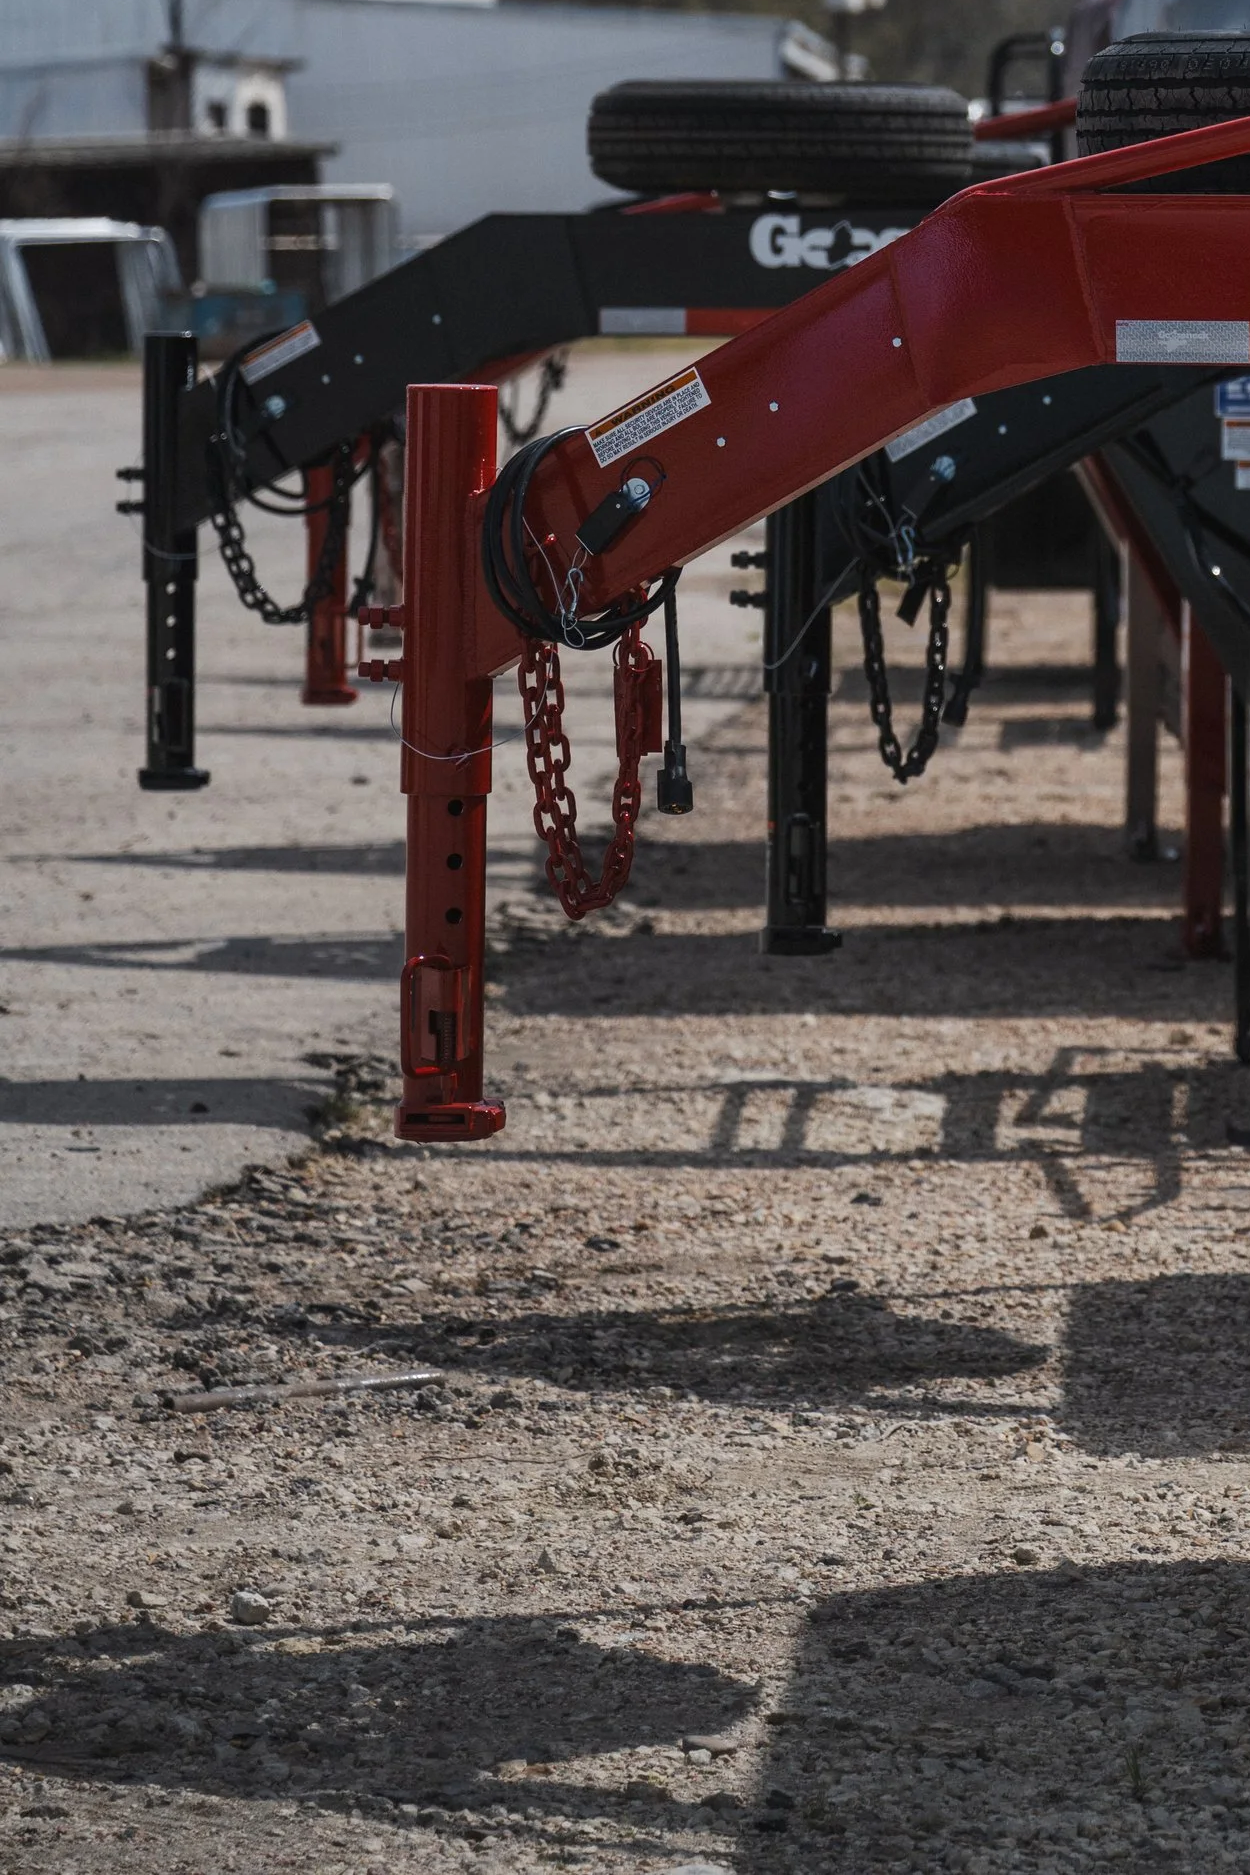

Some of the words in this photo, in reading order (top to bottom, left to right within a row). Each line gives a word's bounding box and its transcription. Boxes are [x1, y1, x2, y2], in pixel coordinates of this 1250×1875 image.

[592, 437, 605, 448] MAKE
[604, 430, 617, 441] SURE
[616, 425, 625, 434] ALL
[624, 413, 645, 429] SECURITY
[644, 403, 663, 417] DEVICES
[662, 397, 672, 407] ARE
[676, 386, 691, 398] PLACE
[689, 381, 700, 390] AND
[610, 383, 675, 427] WARNING
